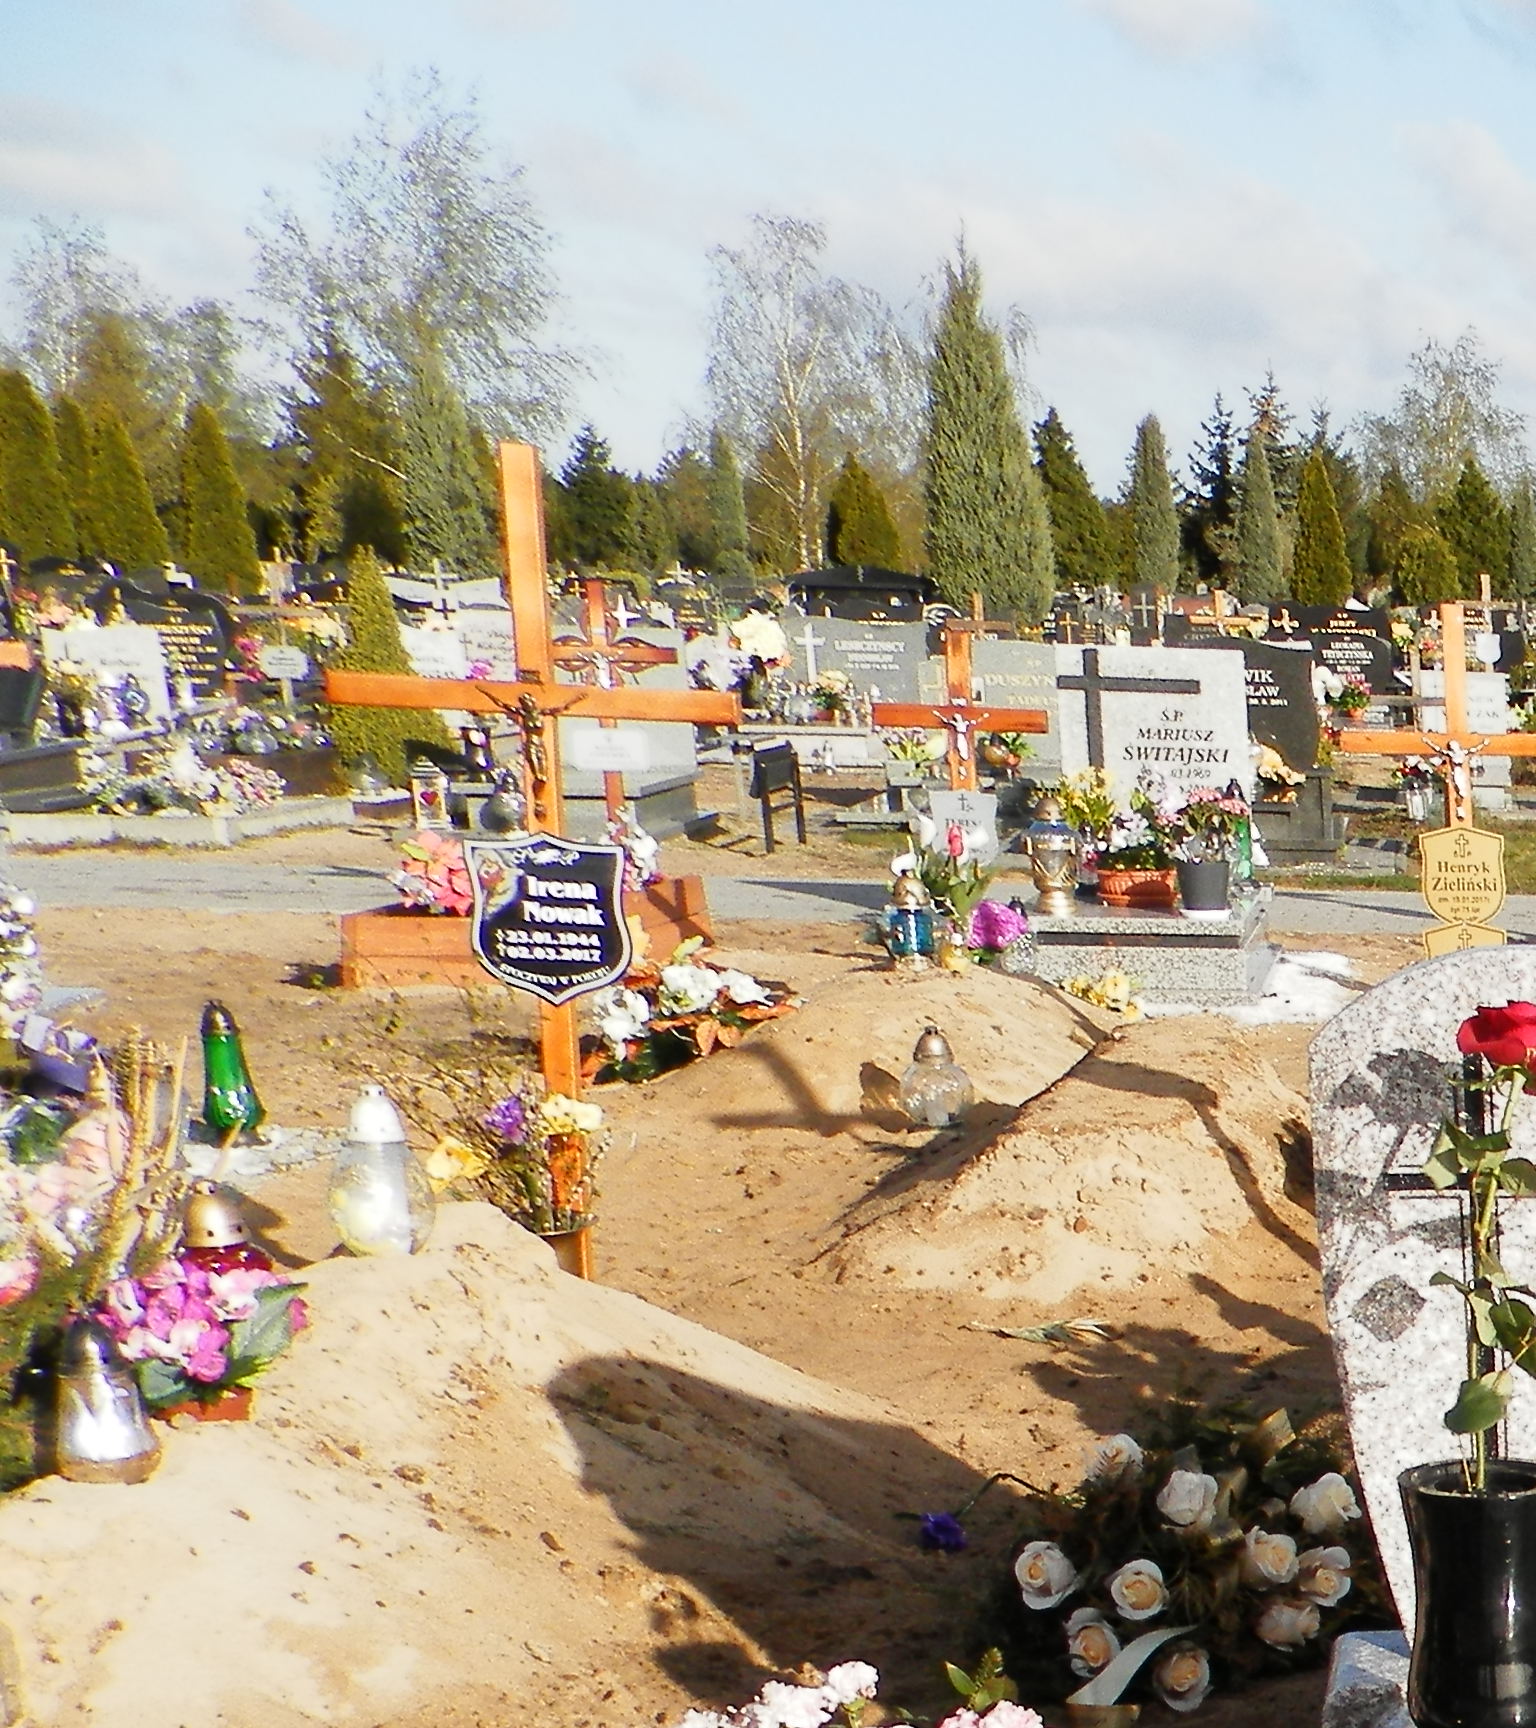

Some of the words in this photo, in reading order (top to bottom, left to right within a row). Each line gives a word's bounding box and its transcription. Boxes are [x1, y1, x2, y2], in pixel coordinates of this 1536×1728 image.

[1136, 728, 1214, 742] MARIUSZ
[1123, 743, 1229, 765] ŚWITAJSKI
[1438, 861, 1490, 876] Henryk
[525, 875, 598, 900] Irena
[1432, 876, 1497, 892] Zieliński
[522, 900, 606, 926] Nowak
